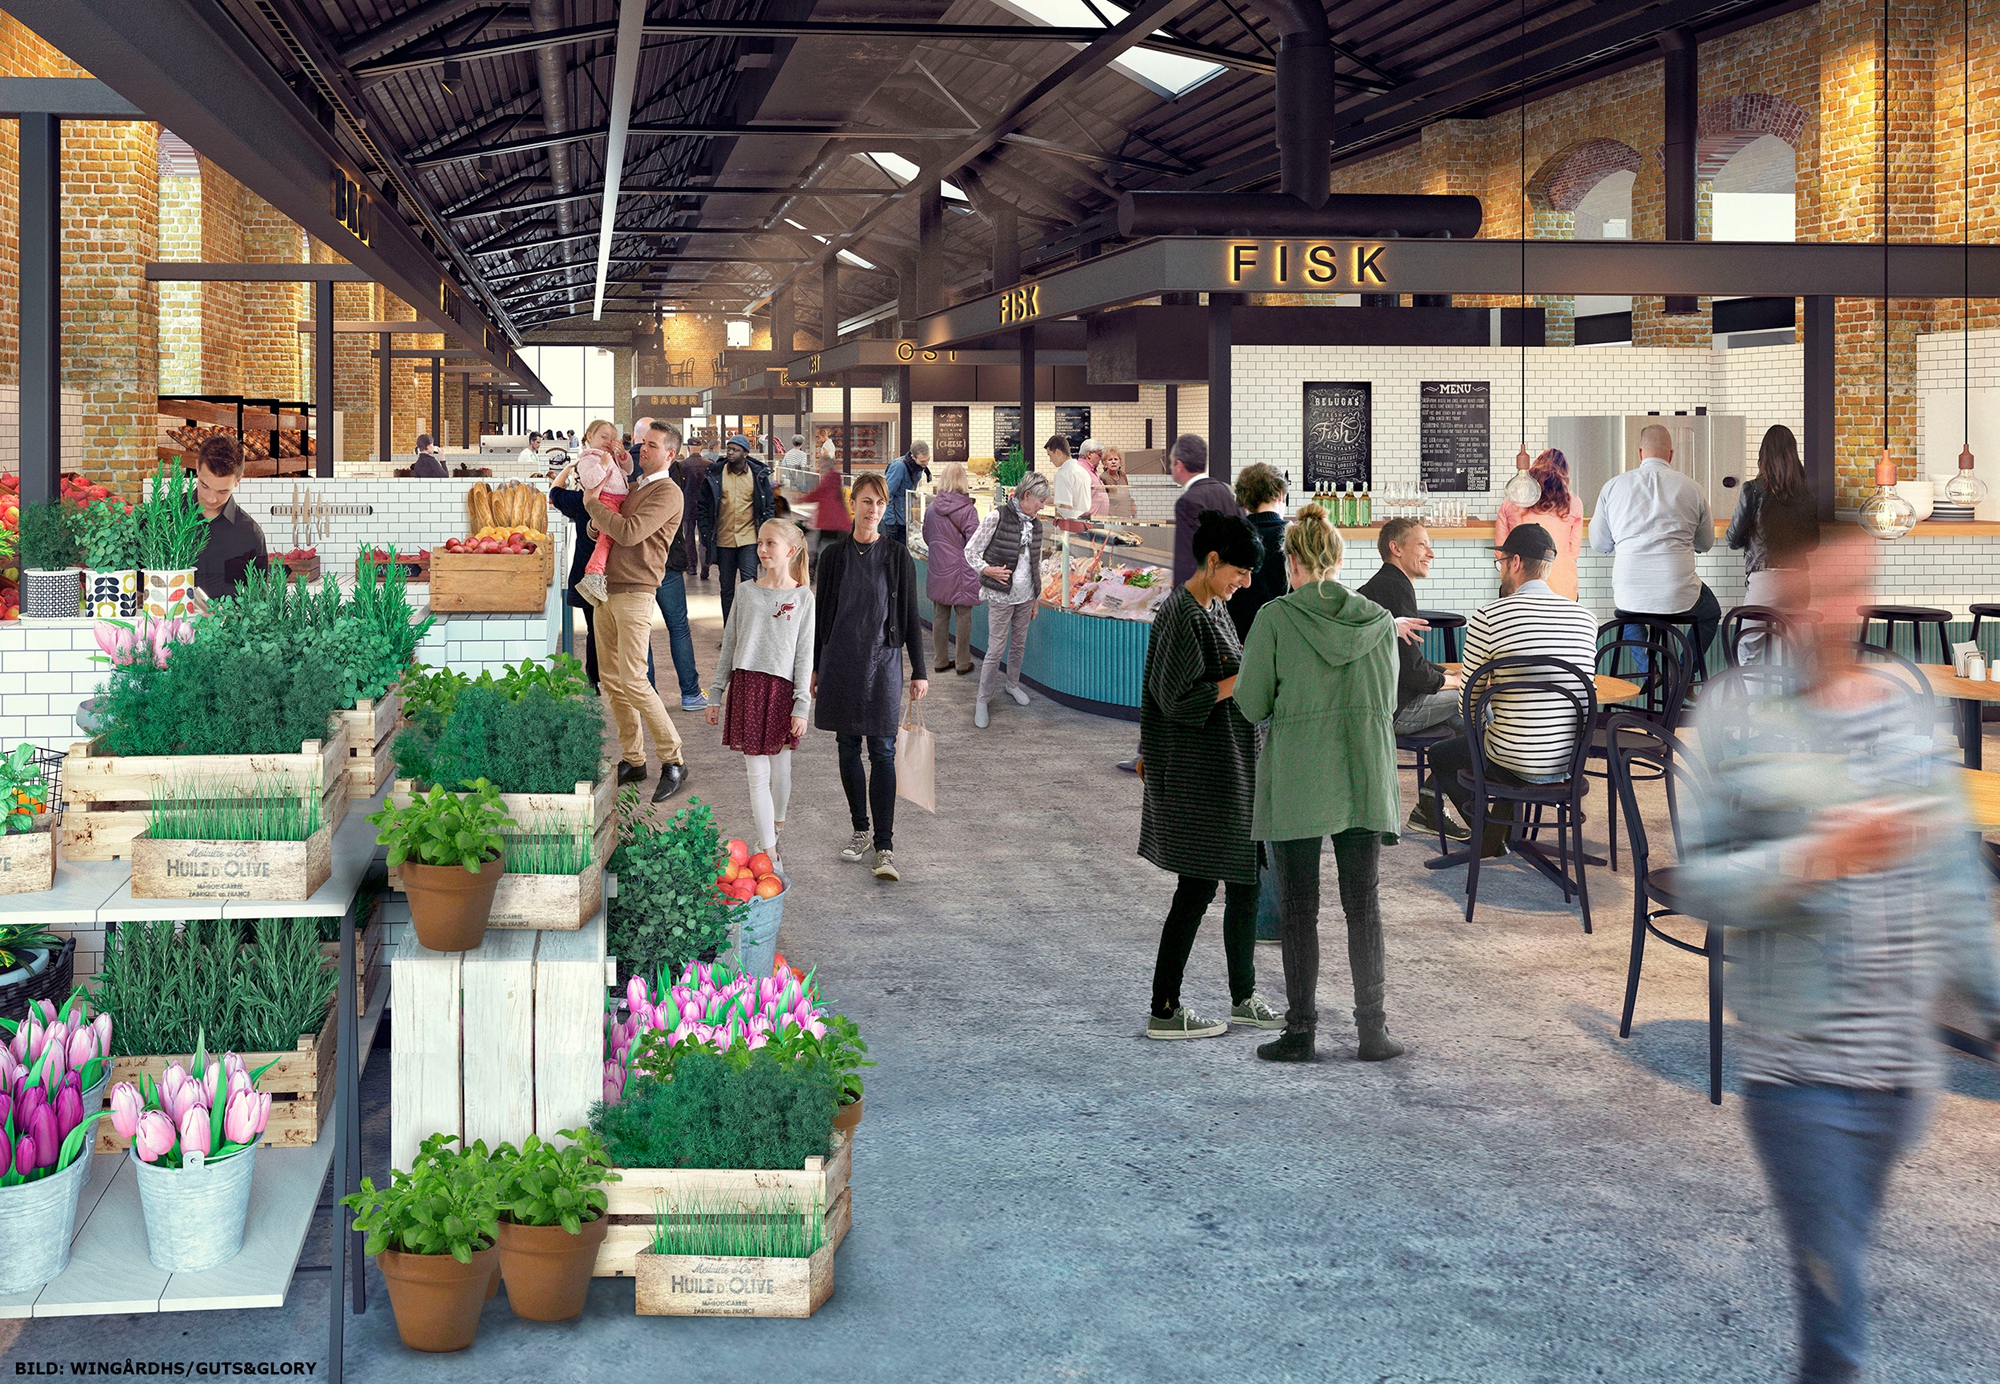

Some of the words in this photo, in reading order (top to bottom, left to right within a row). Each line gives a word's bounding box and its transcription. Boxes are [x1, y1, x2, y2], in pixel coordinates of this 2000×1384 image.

[1234, 245, 1387, 283] FISK
[1000, 286, 1039, 323] FISK
[1440, 384, 1472, 394] MENU
[1314, 396, 1360, 406] BELUGA'S
[1310, 413, 1359, 444] Fish
[167, 859, 209, 877] HUILE
[671, 1275, 714, 1294] HUILE
